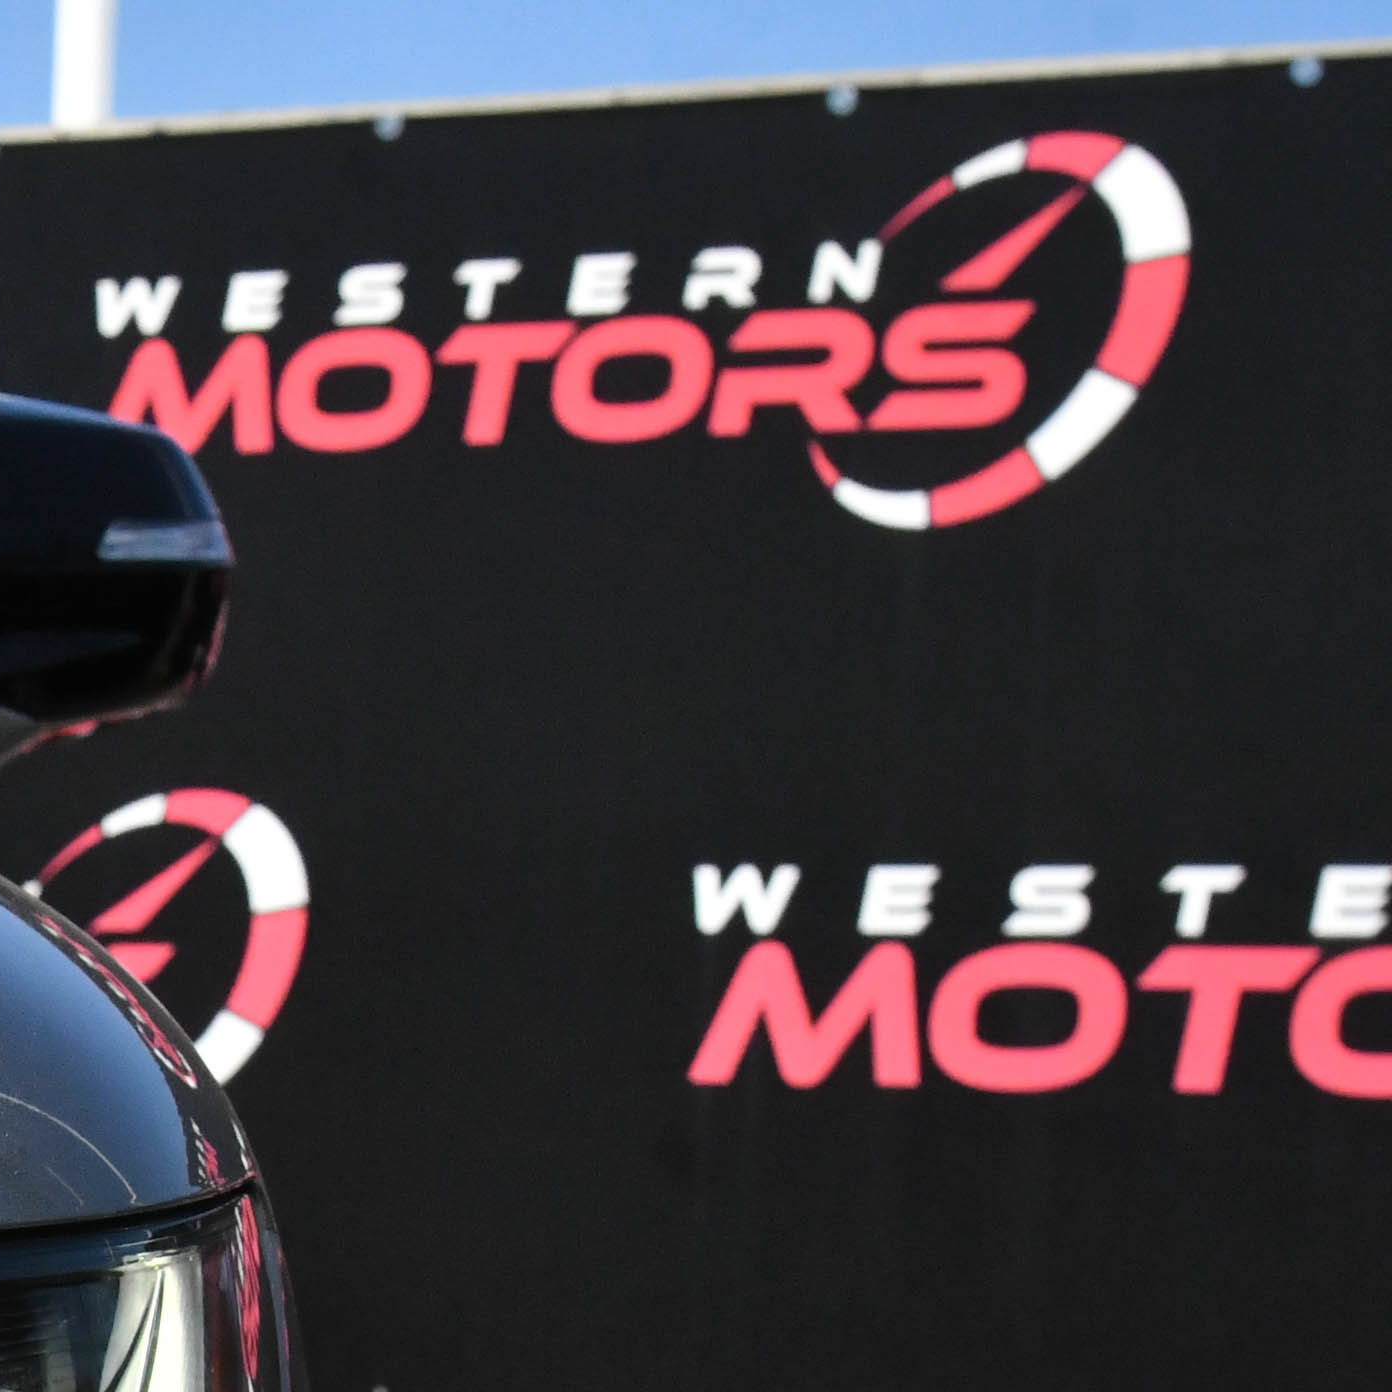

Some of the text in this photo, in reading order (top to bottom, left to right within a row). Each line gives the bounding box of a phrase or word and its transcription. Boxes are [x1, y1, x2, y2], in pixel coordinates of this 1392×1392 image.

[95, 239, 883, 339] WESTERN
[107, 299, 1035, 455] MOTORS
[693, 863, 1392, 939] WESTE
